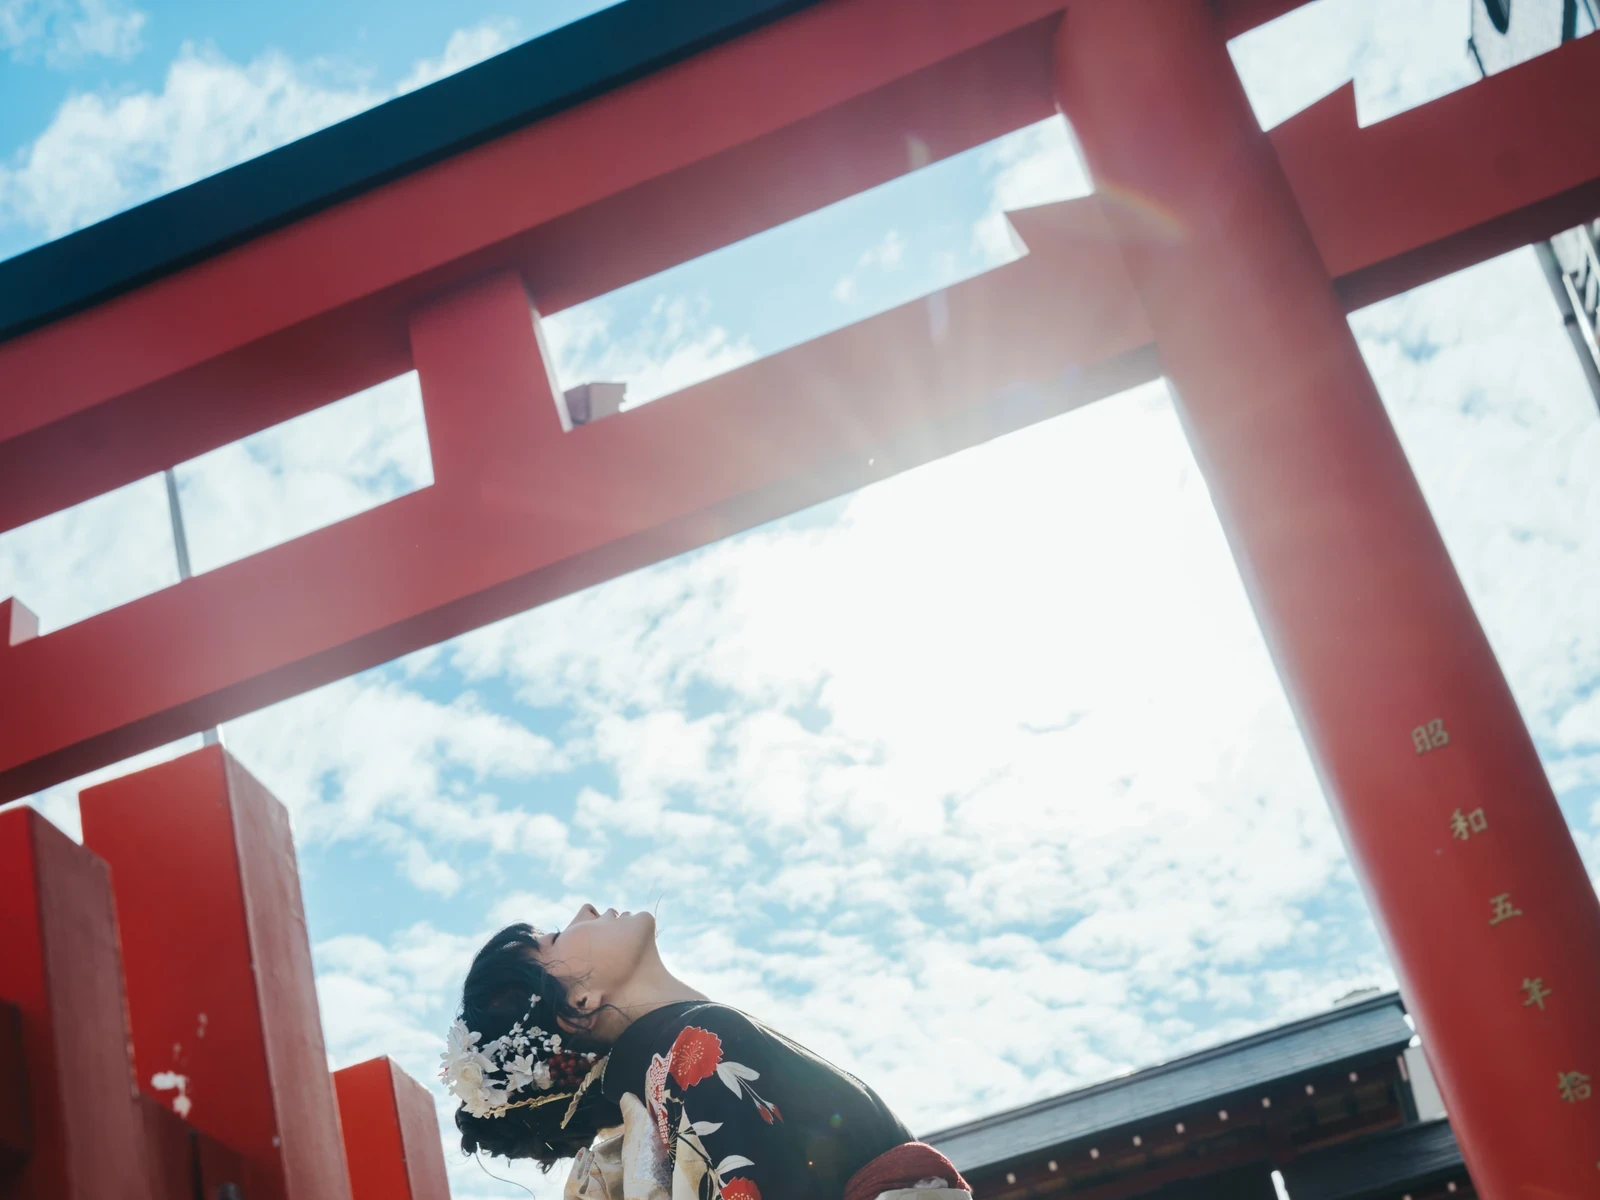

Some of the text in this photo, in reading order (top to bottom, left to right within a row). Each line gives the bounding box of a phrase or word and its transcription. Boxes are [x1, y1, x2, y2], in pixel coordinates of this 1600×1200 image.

[1411, 718, 1600, 1172] 昭和五年拾
